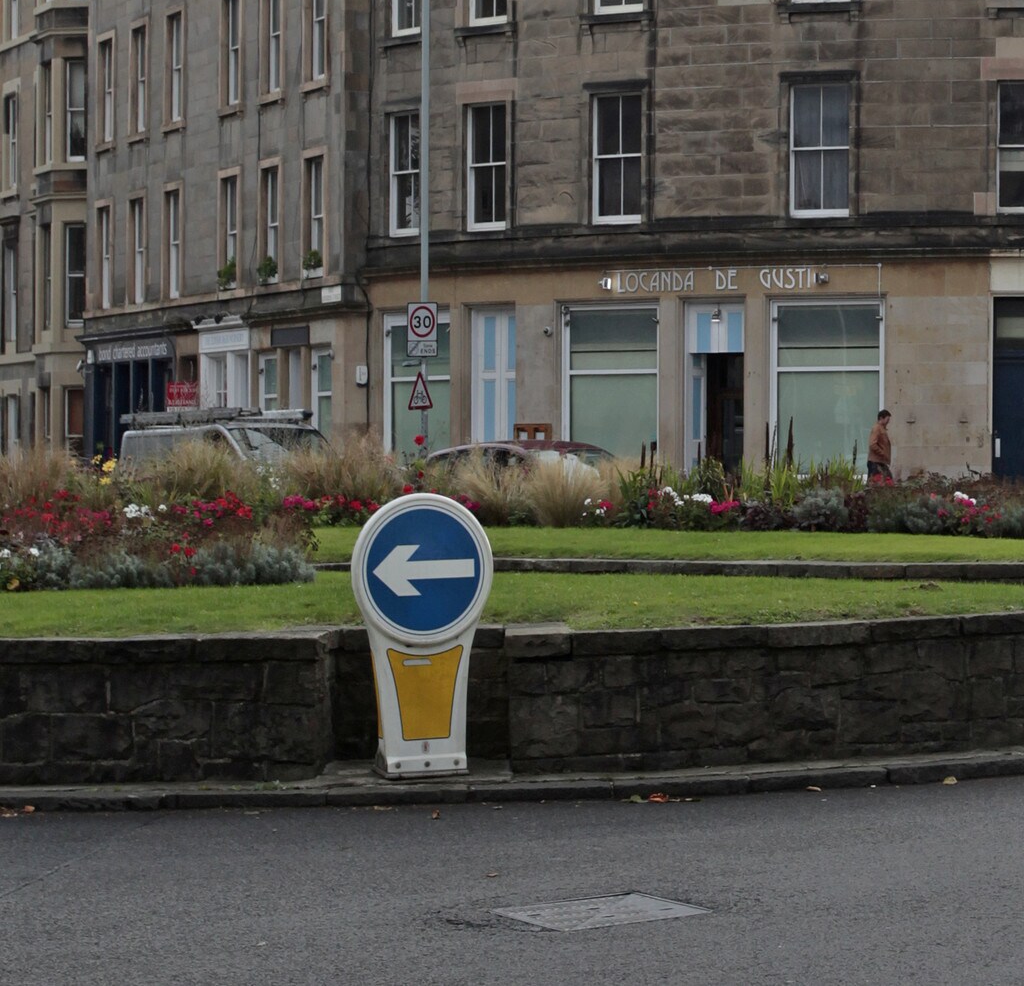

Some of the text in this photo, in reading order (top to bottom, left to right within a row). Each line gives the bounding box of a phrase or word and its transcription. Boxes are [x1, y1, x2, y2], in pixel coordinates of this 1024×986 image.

[617, 268, 811, 293] LOCANDA DE GUSTI
[414, 316, 431, 328] 30
[98, 342, 168, 361] bond chartered accountants
